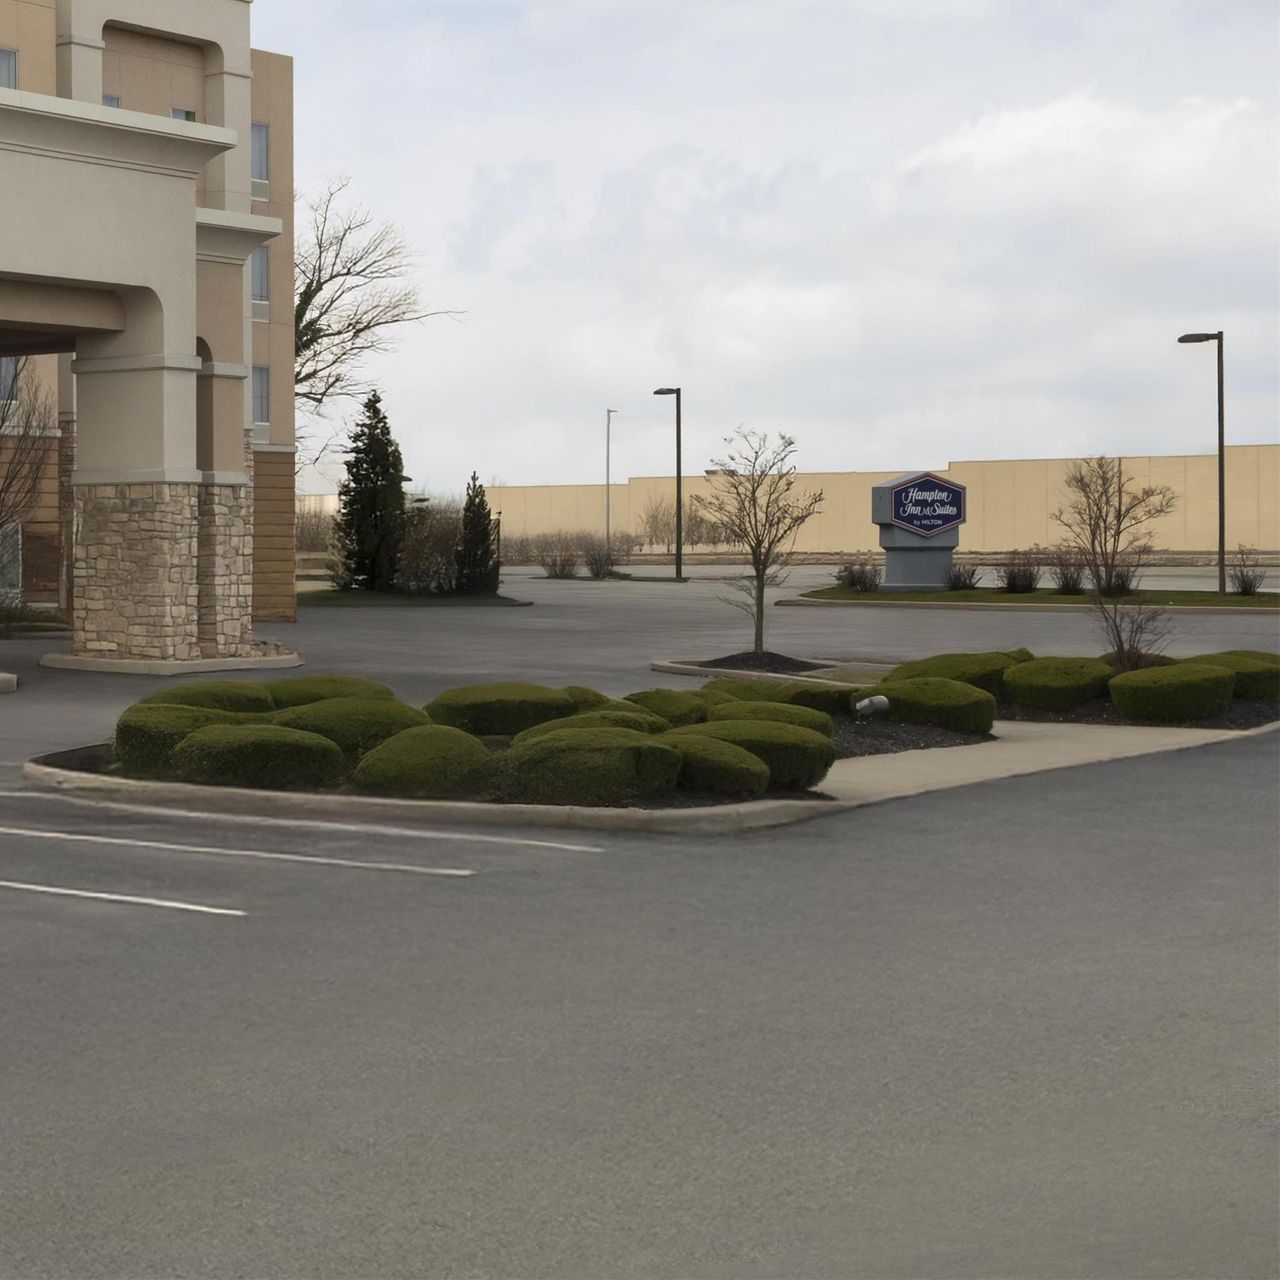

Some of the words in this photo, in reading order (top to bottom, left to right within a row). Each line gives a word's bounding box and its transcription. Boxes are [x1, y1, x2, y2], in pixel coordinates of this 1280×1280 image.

[902, 487, 952, 503] Hampton
[899, 503, 926, 516] Inn
[925, 507, 932, 516] &
[931, 502, 957, 515] Suites
